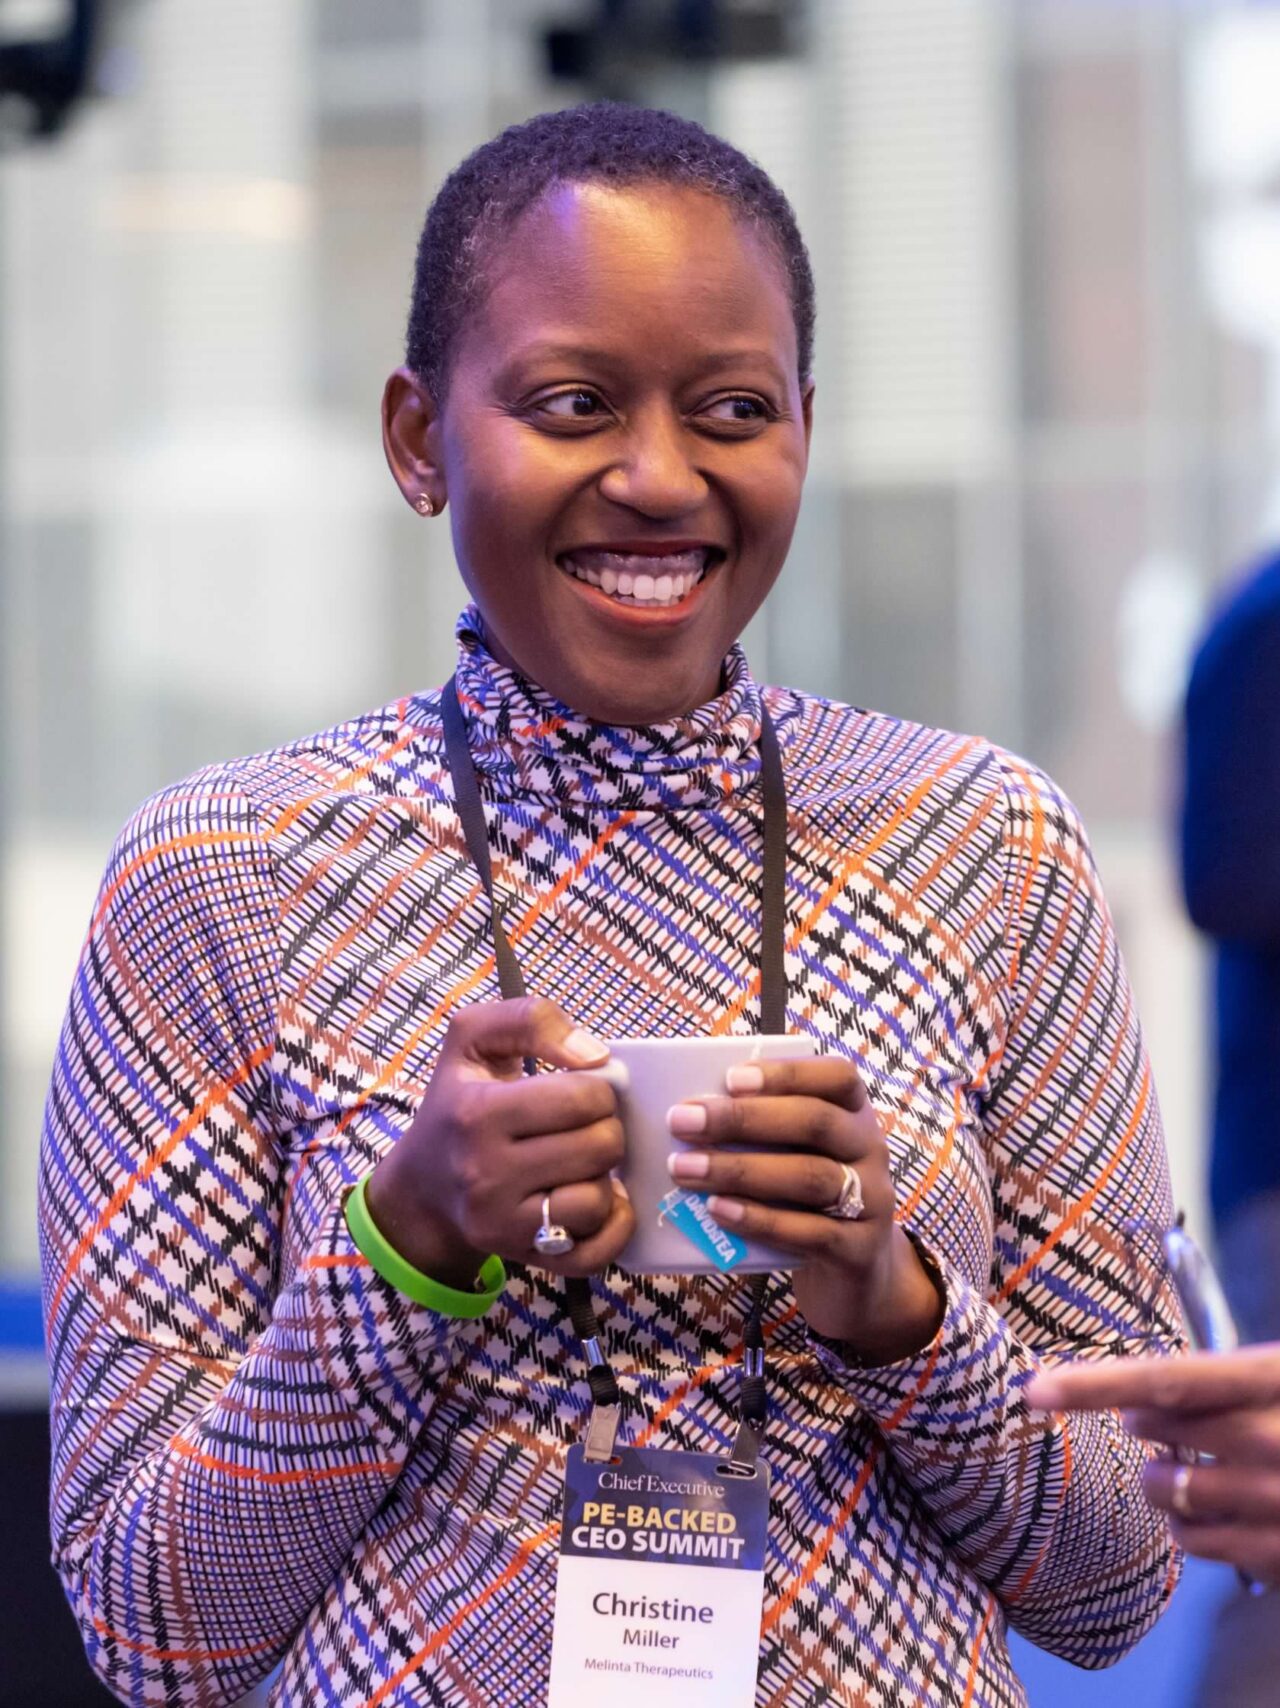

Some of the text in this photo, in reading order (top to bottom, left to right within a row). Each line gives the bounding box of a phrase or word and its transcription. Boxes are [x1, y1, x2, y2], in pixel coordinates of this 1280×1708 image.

[598, 1471, 725, 1498] Chief Executive
[582, 1502, 737, 1534] PE-BACKED
[571, 1526, 745, 1560] CEO SUMMIT
[592, 1592, 714, 1624] Christine
[622, 1628, 680, 1650] Miller
[584, 1658, 714, 1680] Melinta Therapeutics
